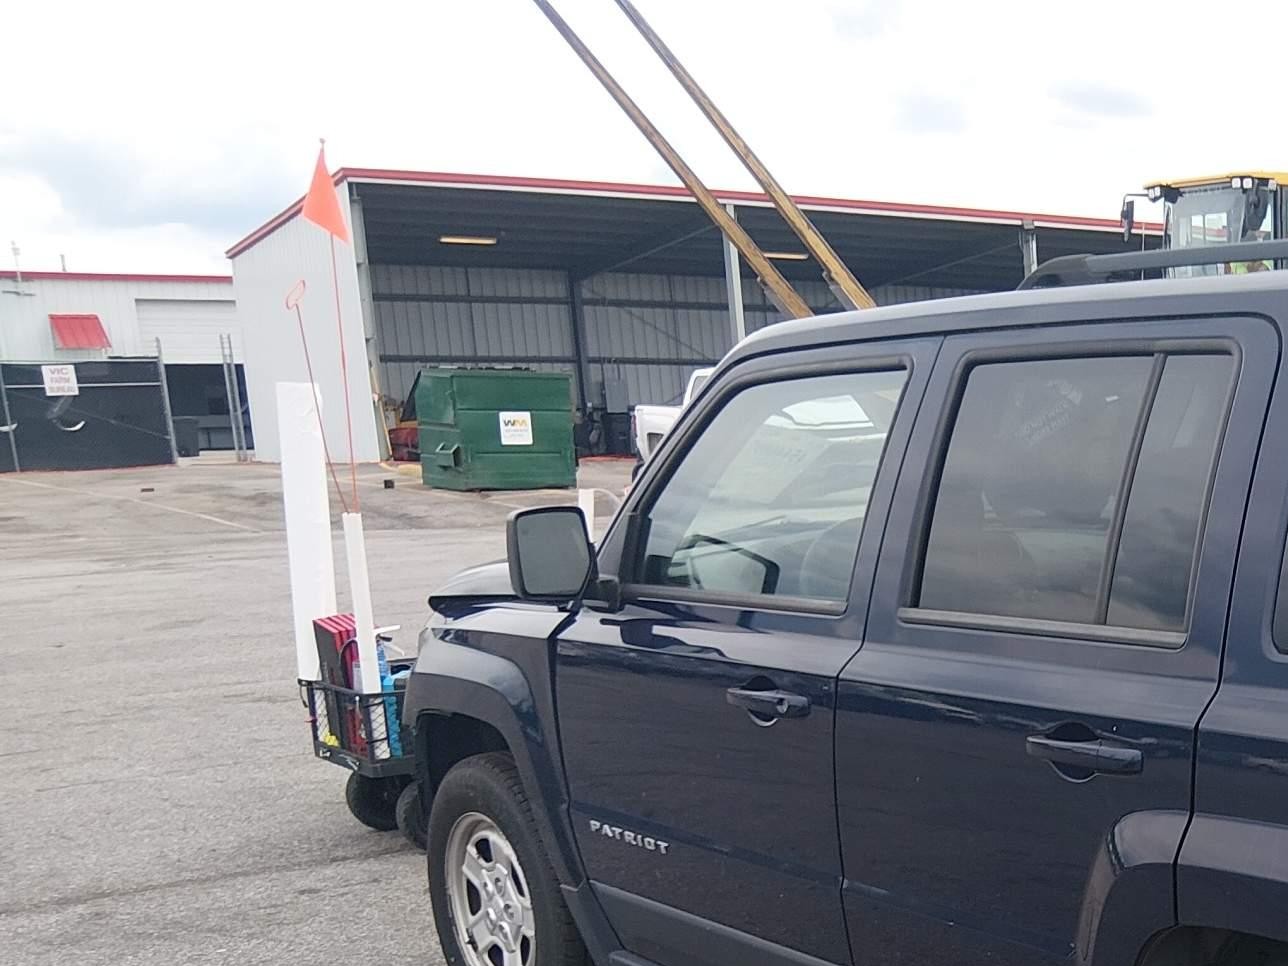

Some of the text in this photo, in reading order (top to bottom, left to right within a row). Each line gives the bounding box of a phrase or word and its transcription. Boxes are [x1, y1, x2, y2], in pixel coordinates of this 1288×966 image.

[48, 367, 69, 375] VIC
[503, 419, 528, 427] WM
[589, 819, 669, 855] PATRIOT
